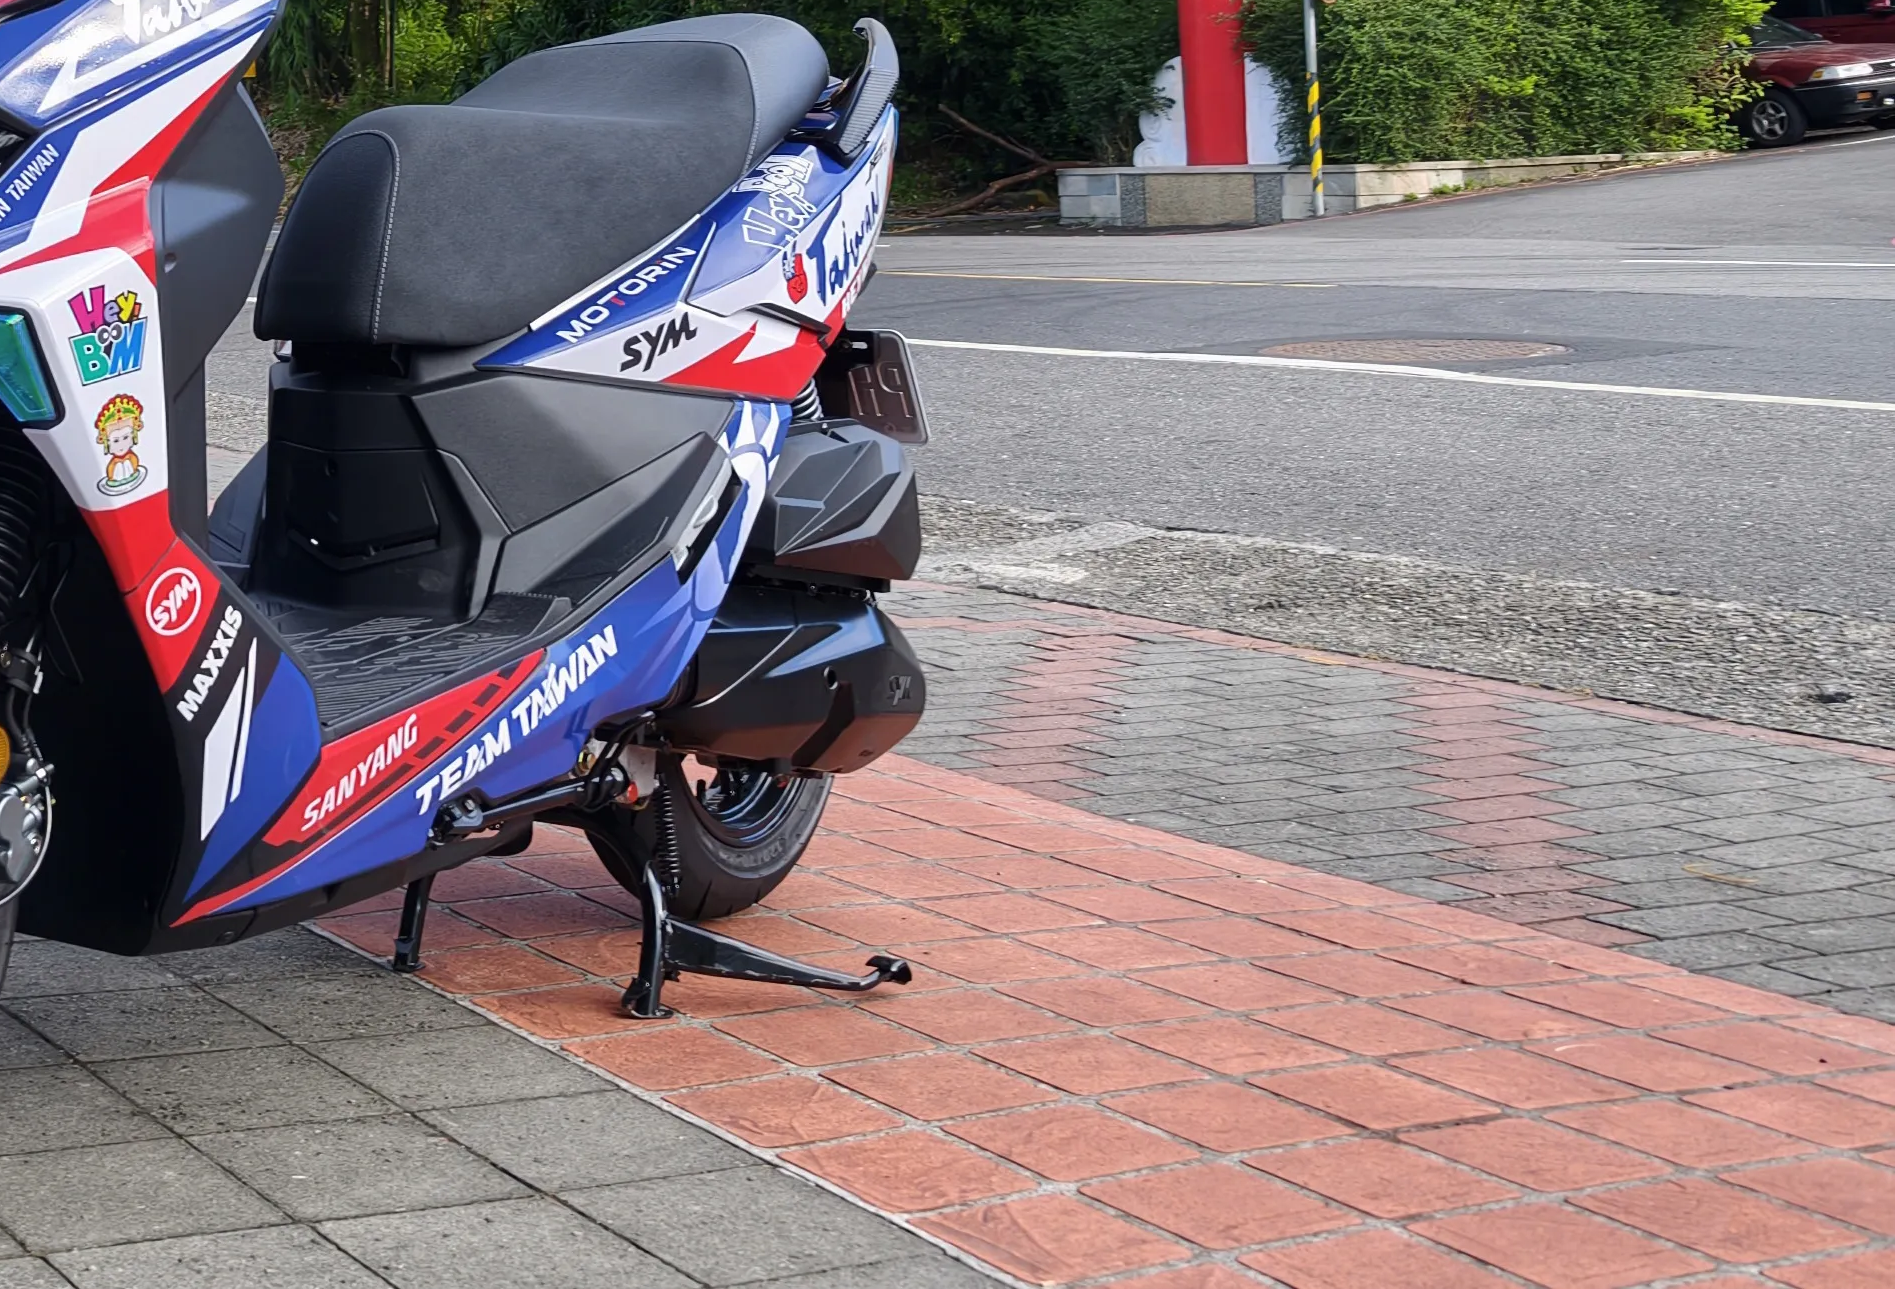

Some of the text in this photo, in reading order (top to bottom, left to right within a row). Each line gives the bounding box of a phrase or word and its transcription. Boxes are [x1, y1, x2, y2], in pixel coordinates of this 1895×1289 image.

[5, 143, 60, 201] TAIWAN
[67, 284, 142, 334] Hey!
[619, 312, 698, 372] SYM
[153, 575, 197, 631] SYM
[176, 604, 243, 722] MAXXIS
[416, 624, 619, 815] TEAM TAIWAN
[301, 713, 418, 832] SANYANG
